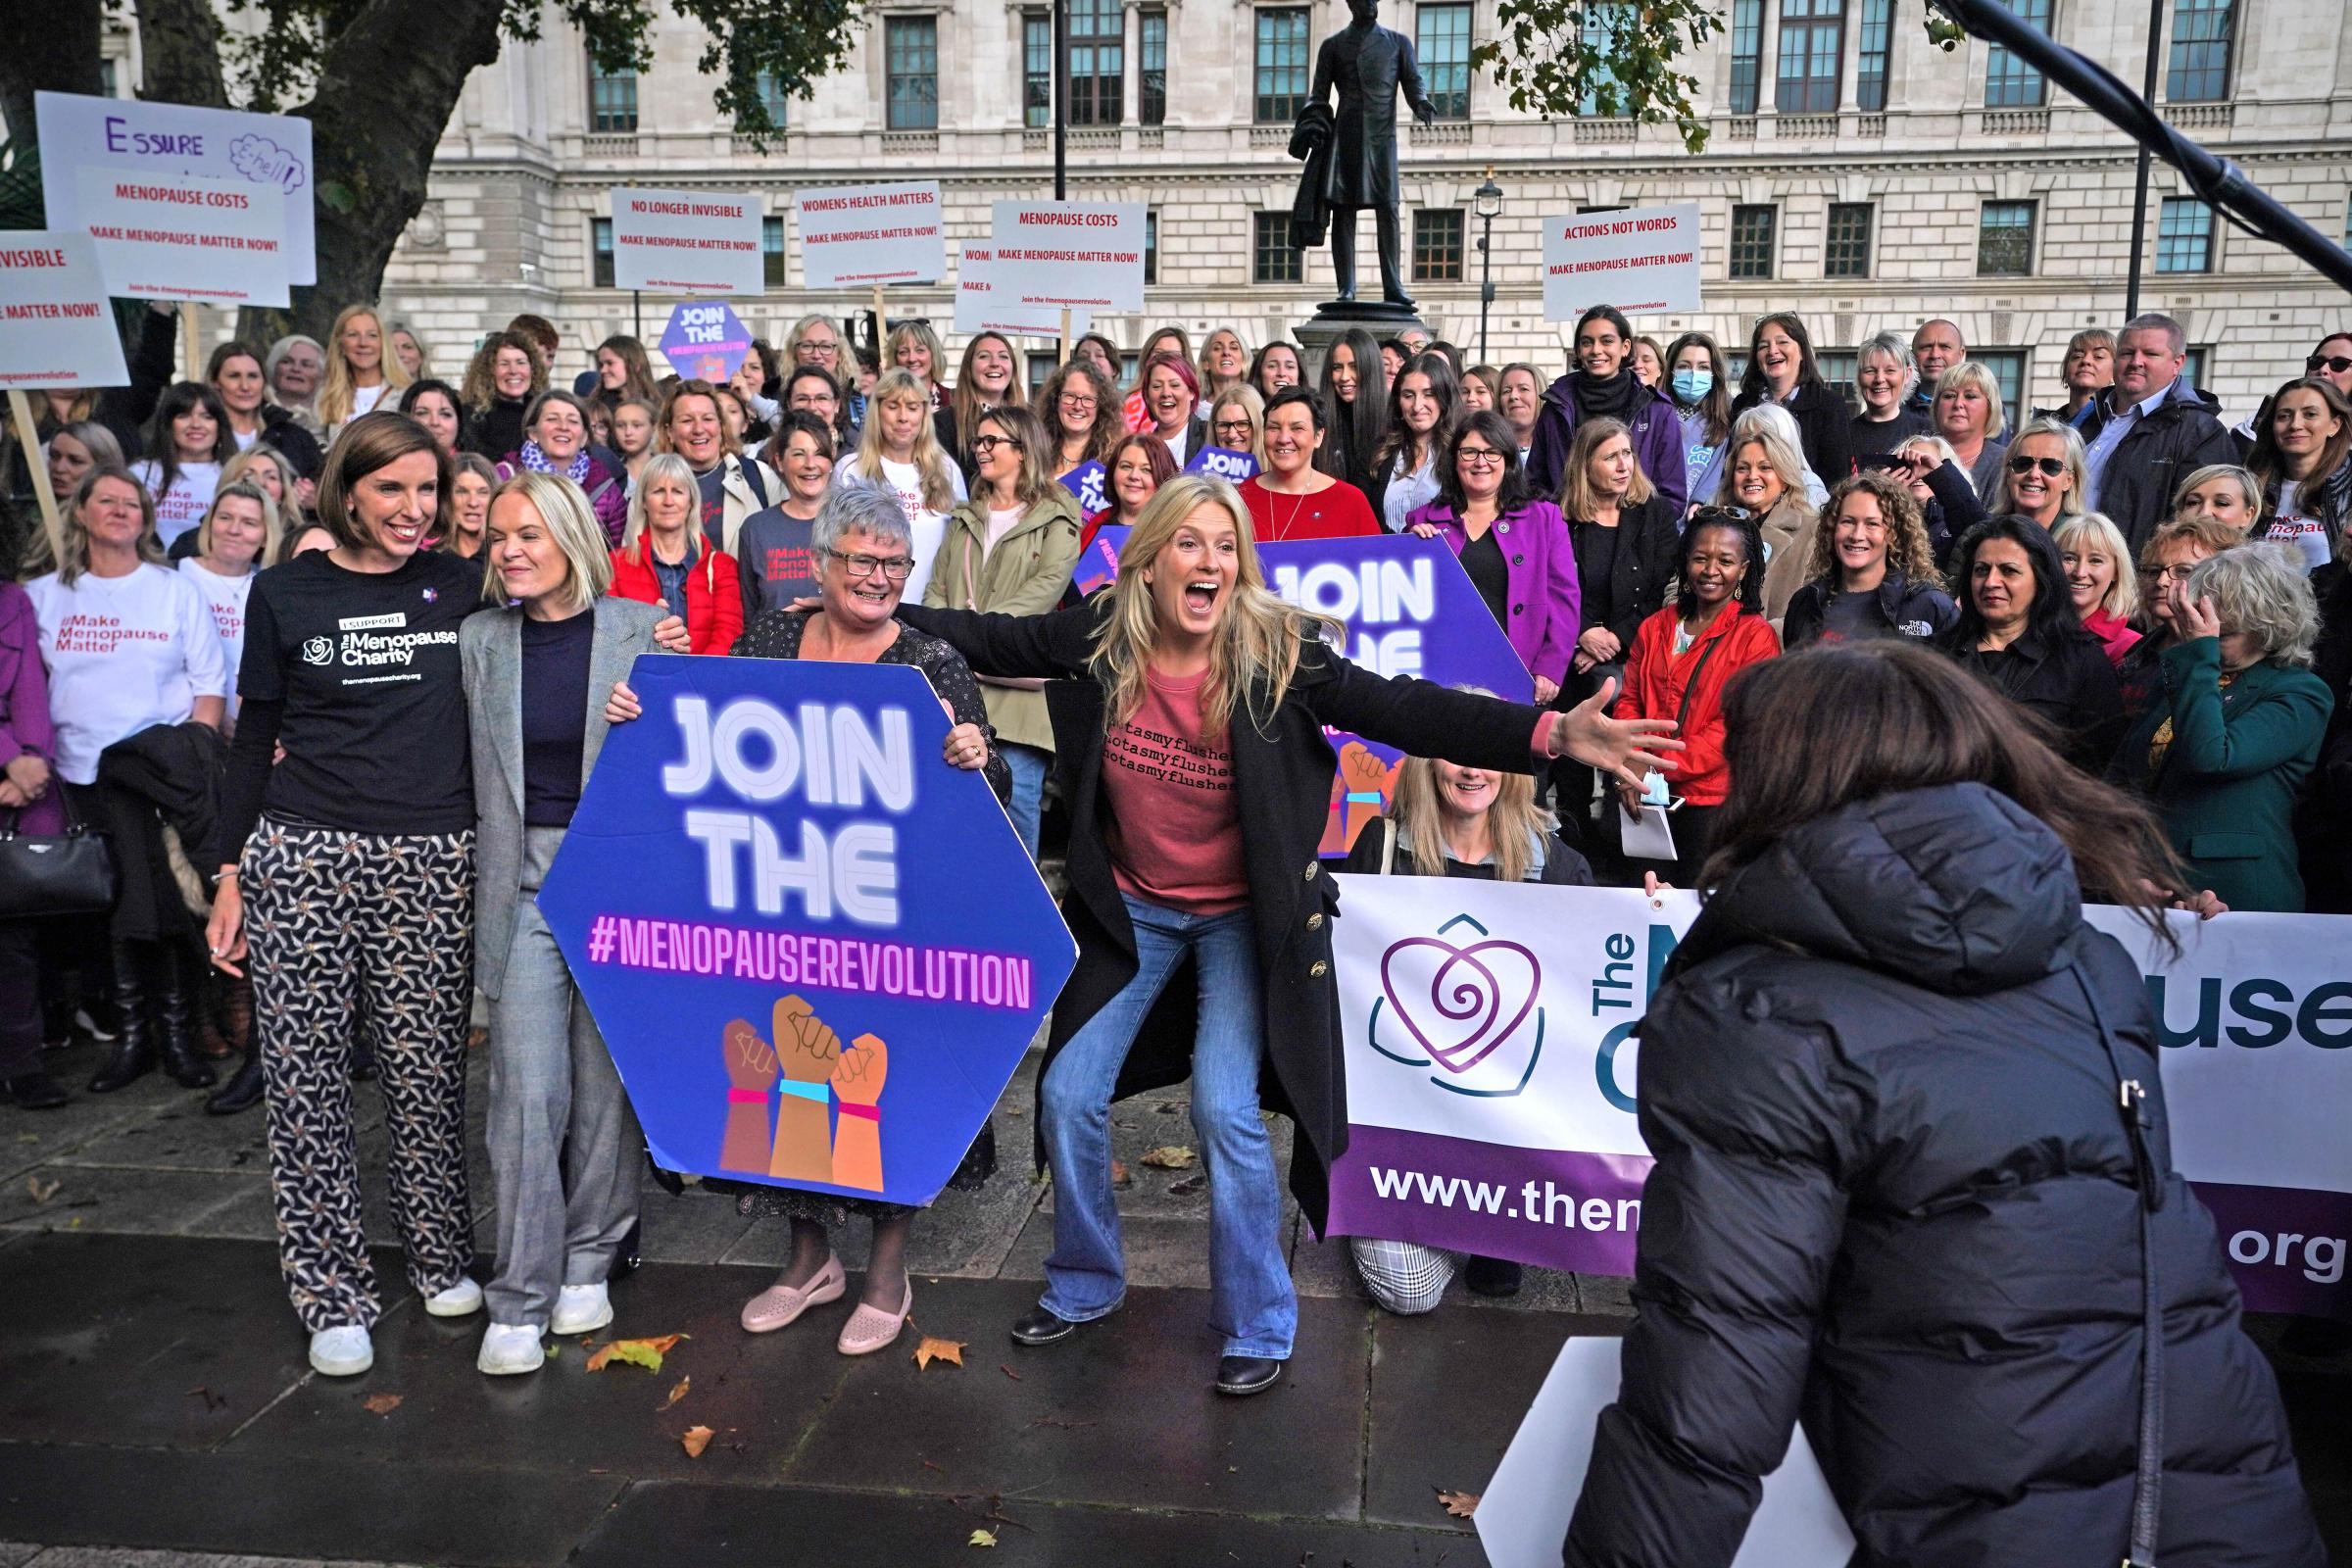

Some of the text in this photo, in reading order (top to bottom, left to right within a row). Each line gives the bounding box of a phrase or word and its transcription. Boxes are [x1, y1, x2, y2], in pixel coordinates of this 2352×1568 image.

[116, 183, 249, 209] MENOPAUSE COSTS
[802, 192, 934, 213] WOMENS HEALTH MATTERS
[631, 200, 743, 218] NO LONGER INVISIBLE
[1019, 212, 1118, 227] MENOPAUSE COSTS
[1564, 217, 1677, 240] ACTIONS NOT WORDS
[89, 225, 278, 252] MAKE MENOPAUSE MATTER NOW!
[619, 234, 757, 252] MAKE MENOPAUSE MATTER NOW!
[806, 226, 938, 244] MAKE MENOPAUSE MATTER NOW!
[0, 249, 67, 268] VISIBLE
[965, 250, 992, 261] WOM
[998, 249, 1139, 264] MAKE MENOPAUSE MATTER NOW!
[1549, 252, 1693, 275] MAKE MENOPAUSE MATTER NOW!
[856, 270, 918, 282] #menopauserevolution
[669, 281, 733, 291] #menopauserevolution
[962, 281, 984, 291] MAKE
[6, 304, 60, 318] MATTER
[62, 303, 101, 318] NOW!
[1021, 295, 1034, 304] Join
[1045, 297, 1111, 308] #menopauserevolution
[1615, 300, 1667, 312] opauserevolution
[680, 307, 725, 326] JOIN
[685, 324, 723, 343] THE
[1202, 453, 1252, 478] JOIN
[154, 510, 189, 519] atter
[61, 615, 120, 627] #Make
[350, 616, 402, 628] SUPPORT
[58, 628, 170, 642] Menopause
[350, 631, 458, 651] Menopause
[56, 639, 118, 653] Matter
[342, 648, 414, 666] Charity
[342, 673, 421, 685] themenopausecharity.org
[663, 698, 913, 810] JOIN
[686, 811, 898, 924] THE
[589, 916, 1030, 1008] #MENOPAUSEREVOLUTION
[1592, 932, 1636, 1017] The
